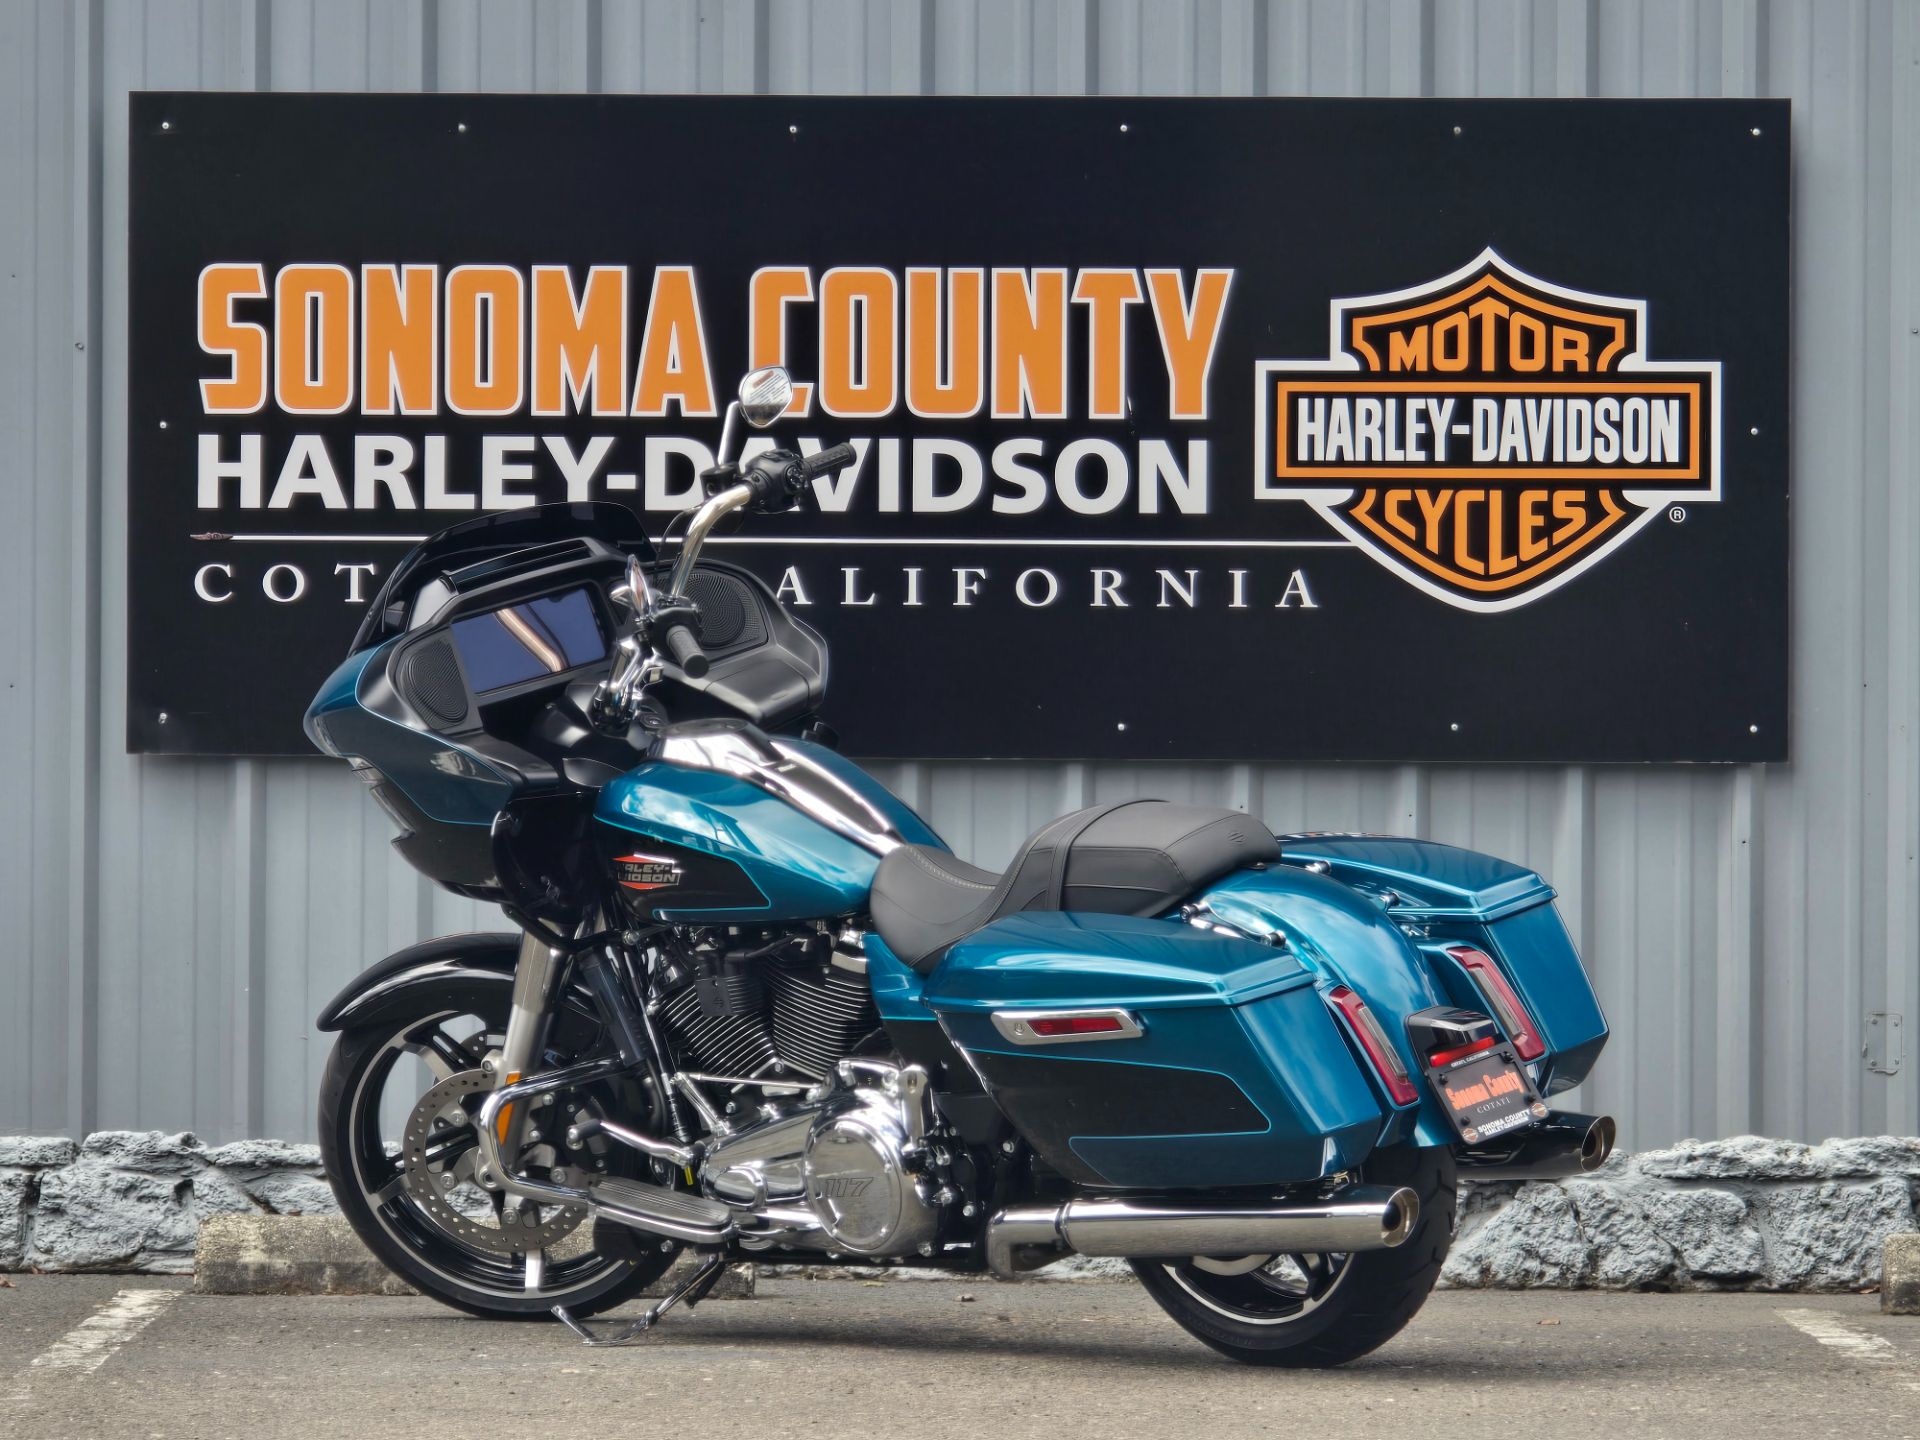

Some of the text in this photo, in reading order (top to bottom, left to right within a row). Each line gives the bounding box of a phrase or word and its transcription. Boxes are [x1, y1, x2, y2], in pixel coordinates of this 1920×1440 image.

[197, 263, 1234, 420] SONOMA COUNTY
[1388, 295, 1590, 373] MOTOR
[1298, 396, 1680, 464] HARLEY-DAVIDSON
[1384, 488, 1586, 575] CYCLES
[194, 563, 1319, 609] COT ALIFORNIA
[1476, 1096, 1511, 1114] COTATI
[1477, 1117, 1506, 1133] SONOMA
[1505, 1109, 1531, 1123] COUNTY
[823, 1176, 874, 1198] 117
